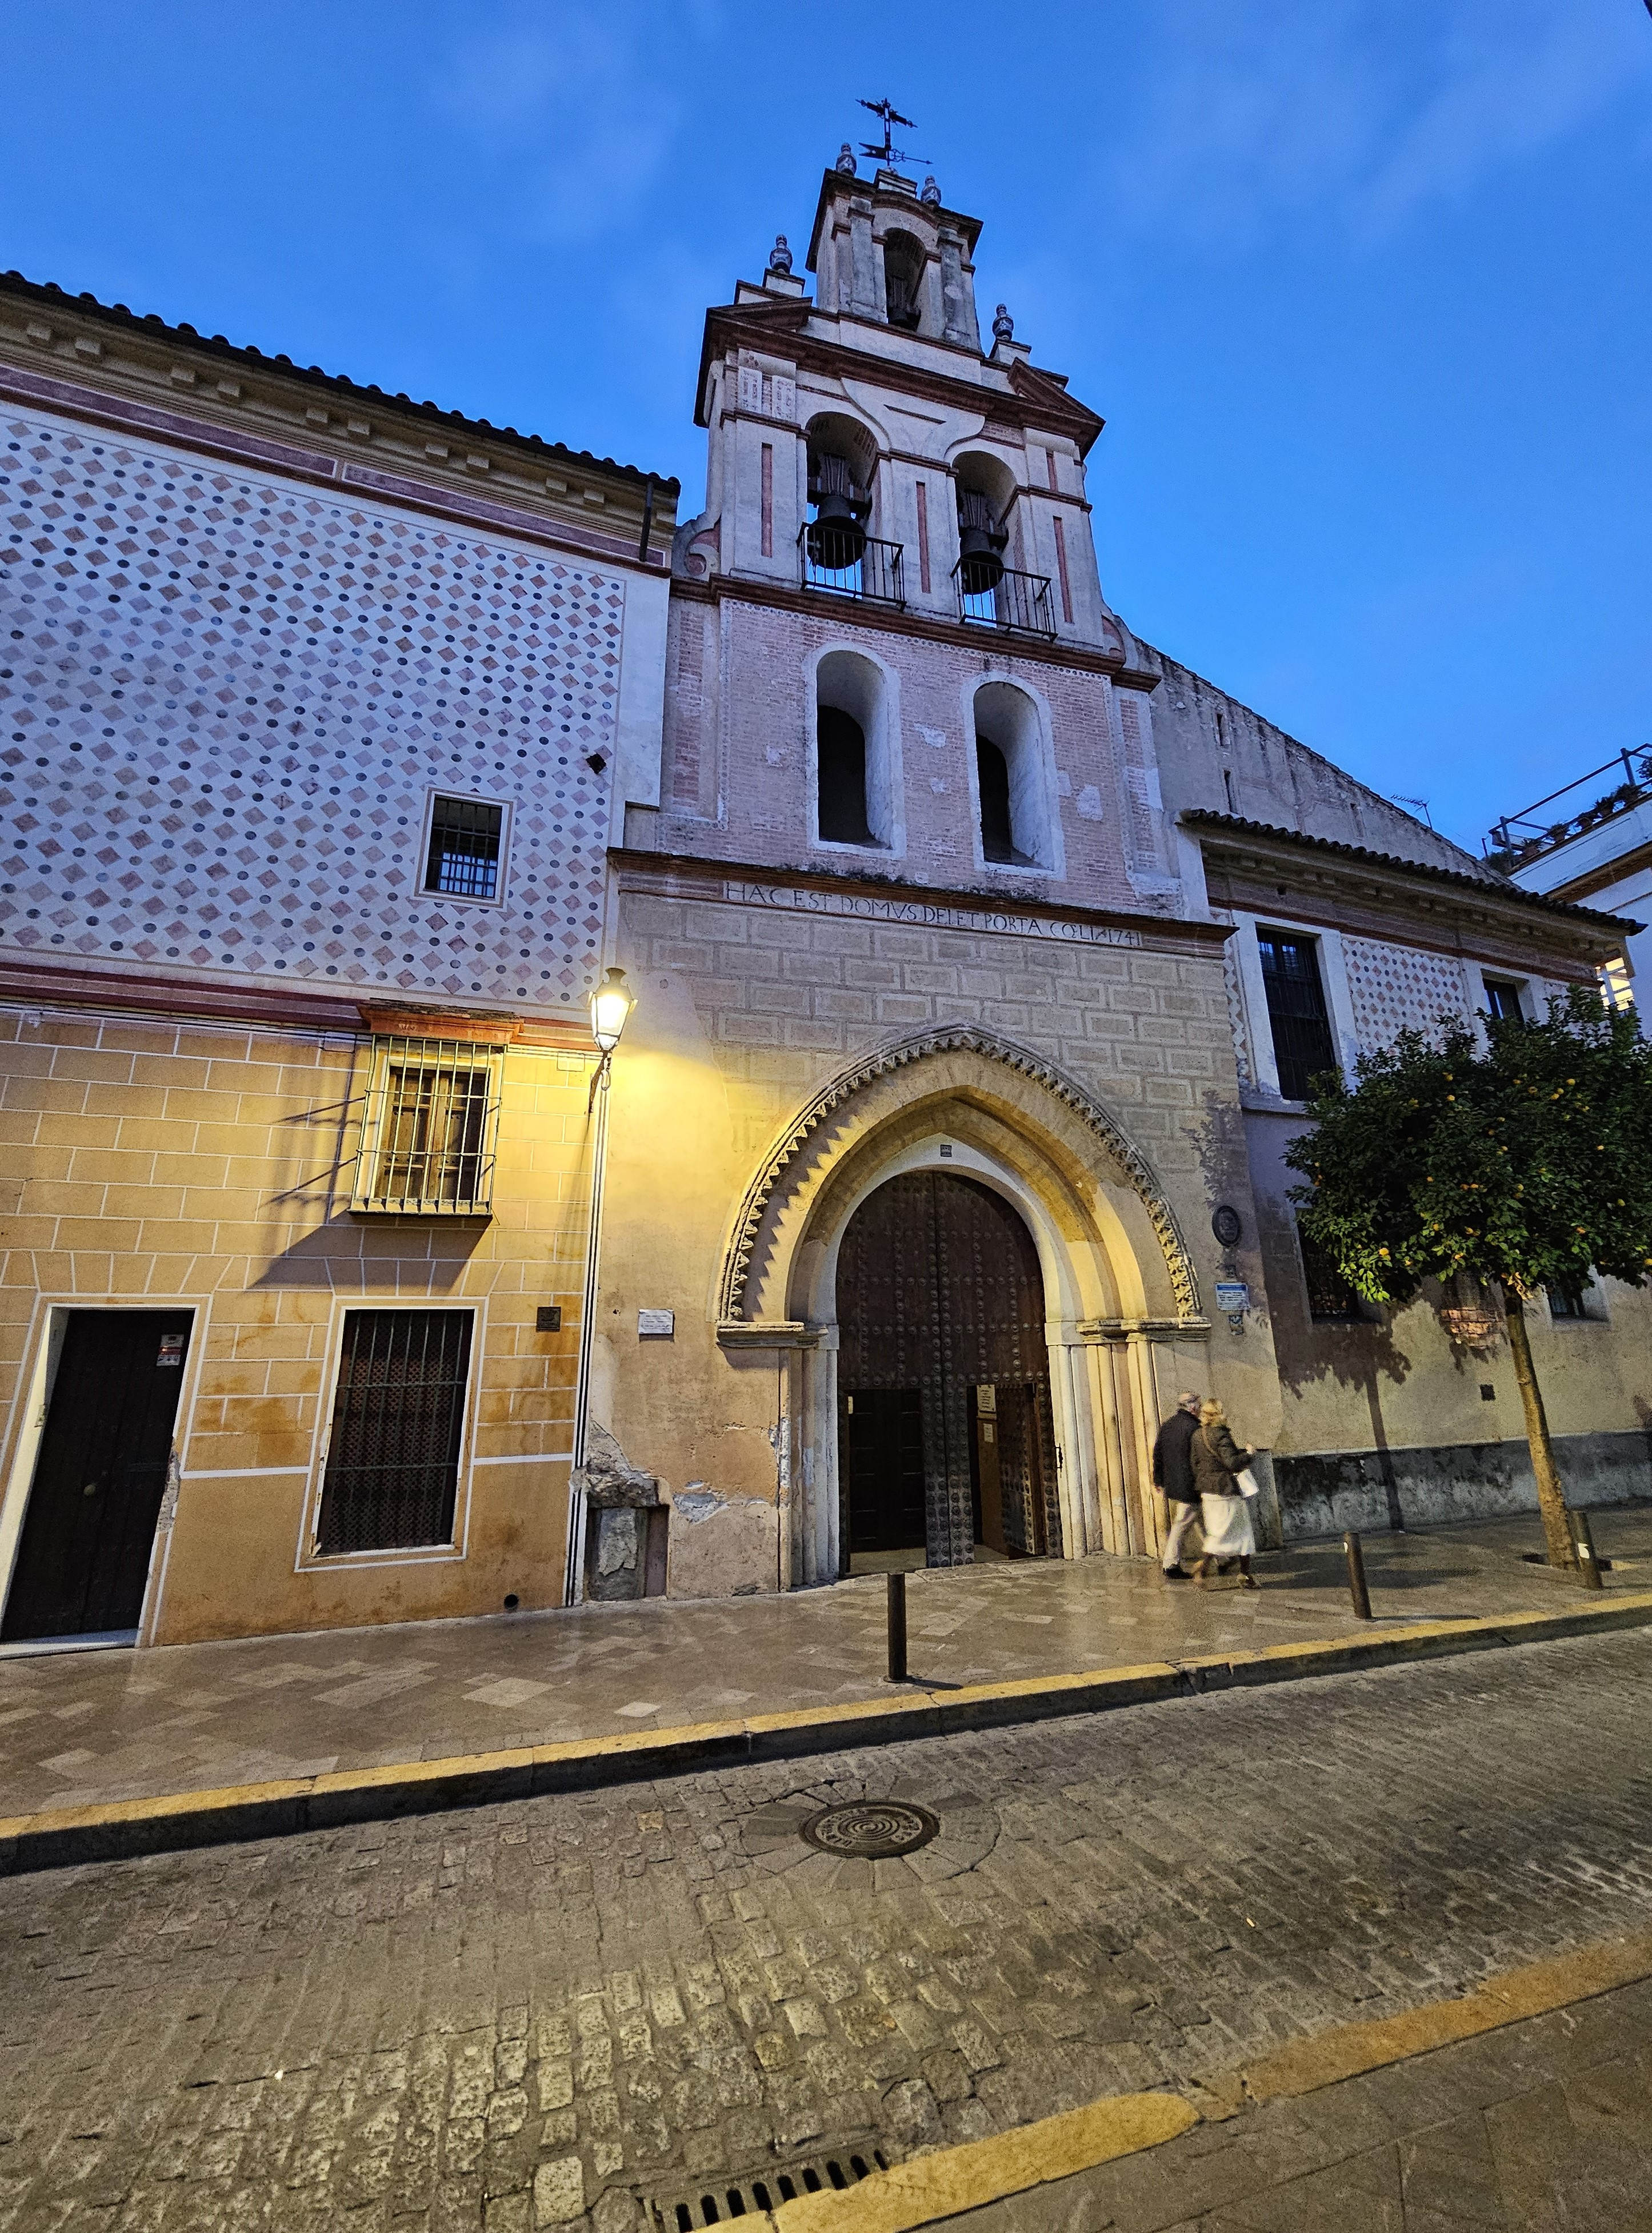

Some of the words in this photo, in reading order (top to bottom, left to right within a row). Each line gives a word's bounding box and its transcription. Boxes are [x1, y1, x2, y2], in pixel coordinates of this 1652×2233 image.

[793, 890, 832, 910] EST
[957, 910, 979, 927] ET
[982, 913, 1043, 935] PORTA
[1109, 929, 1140, 946] 1741
